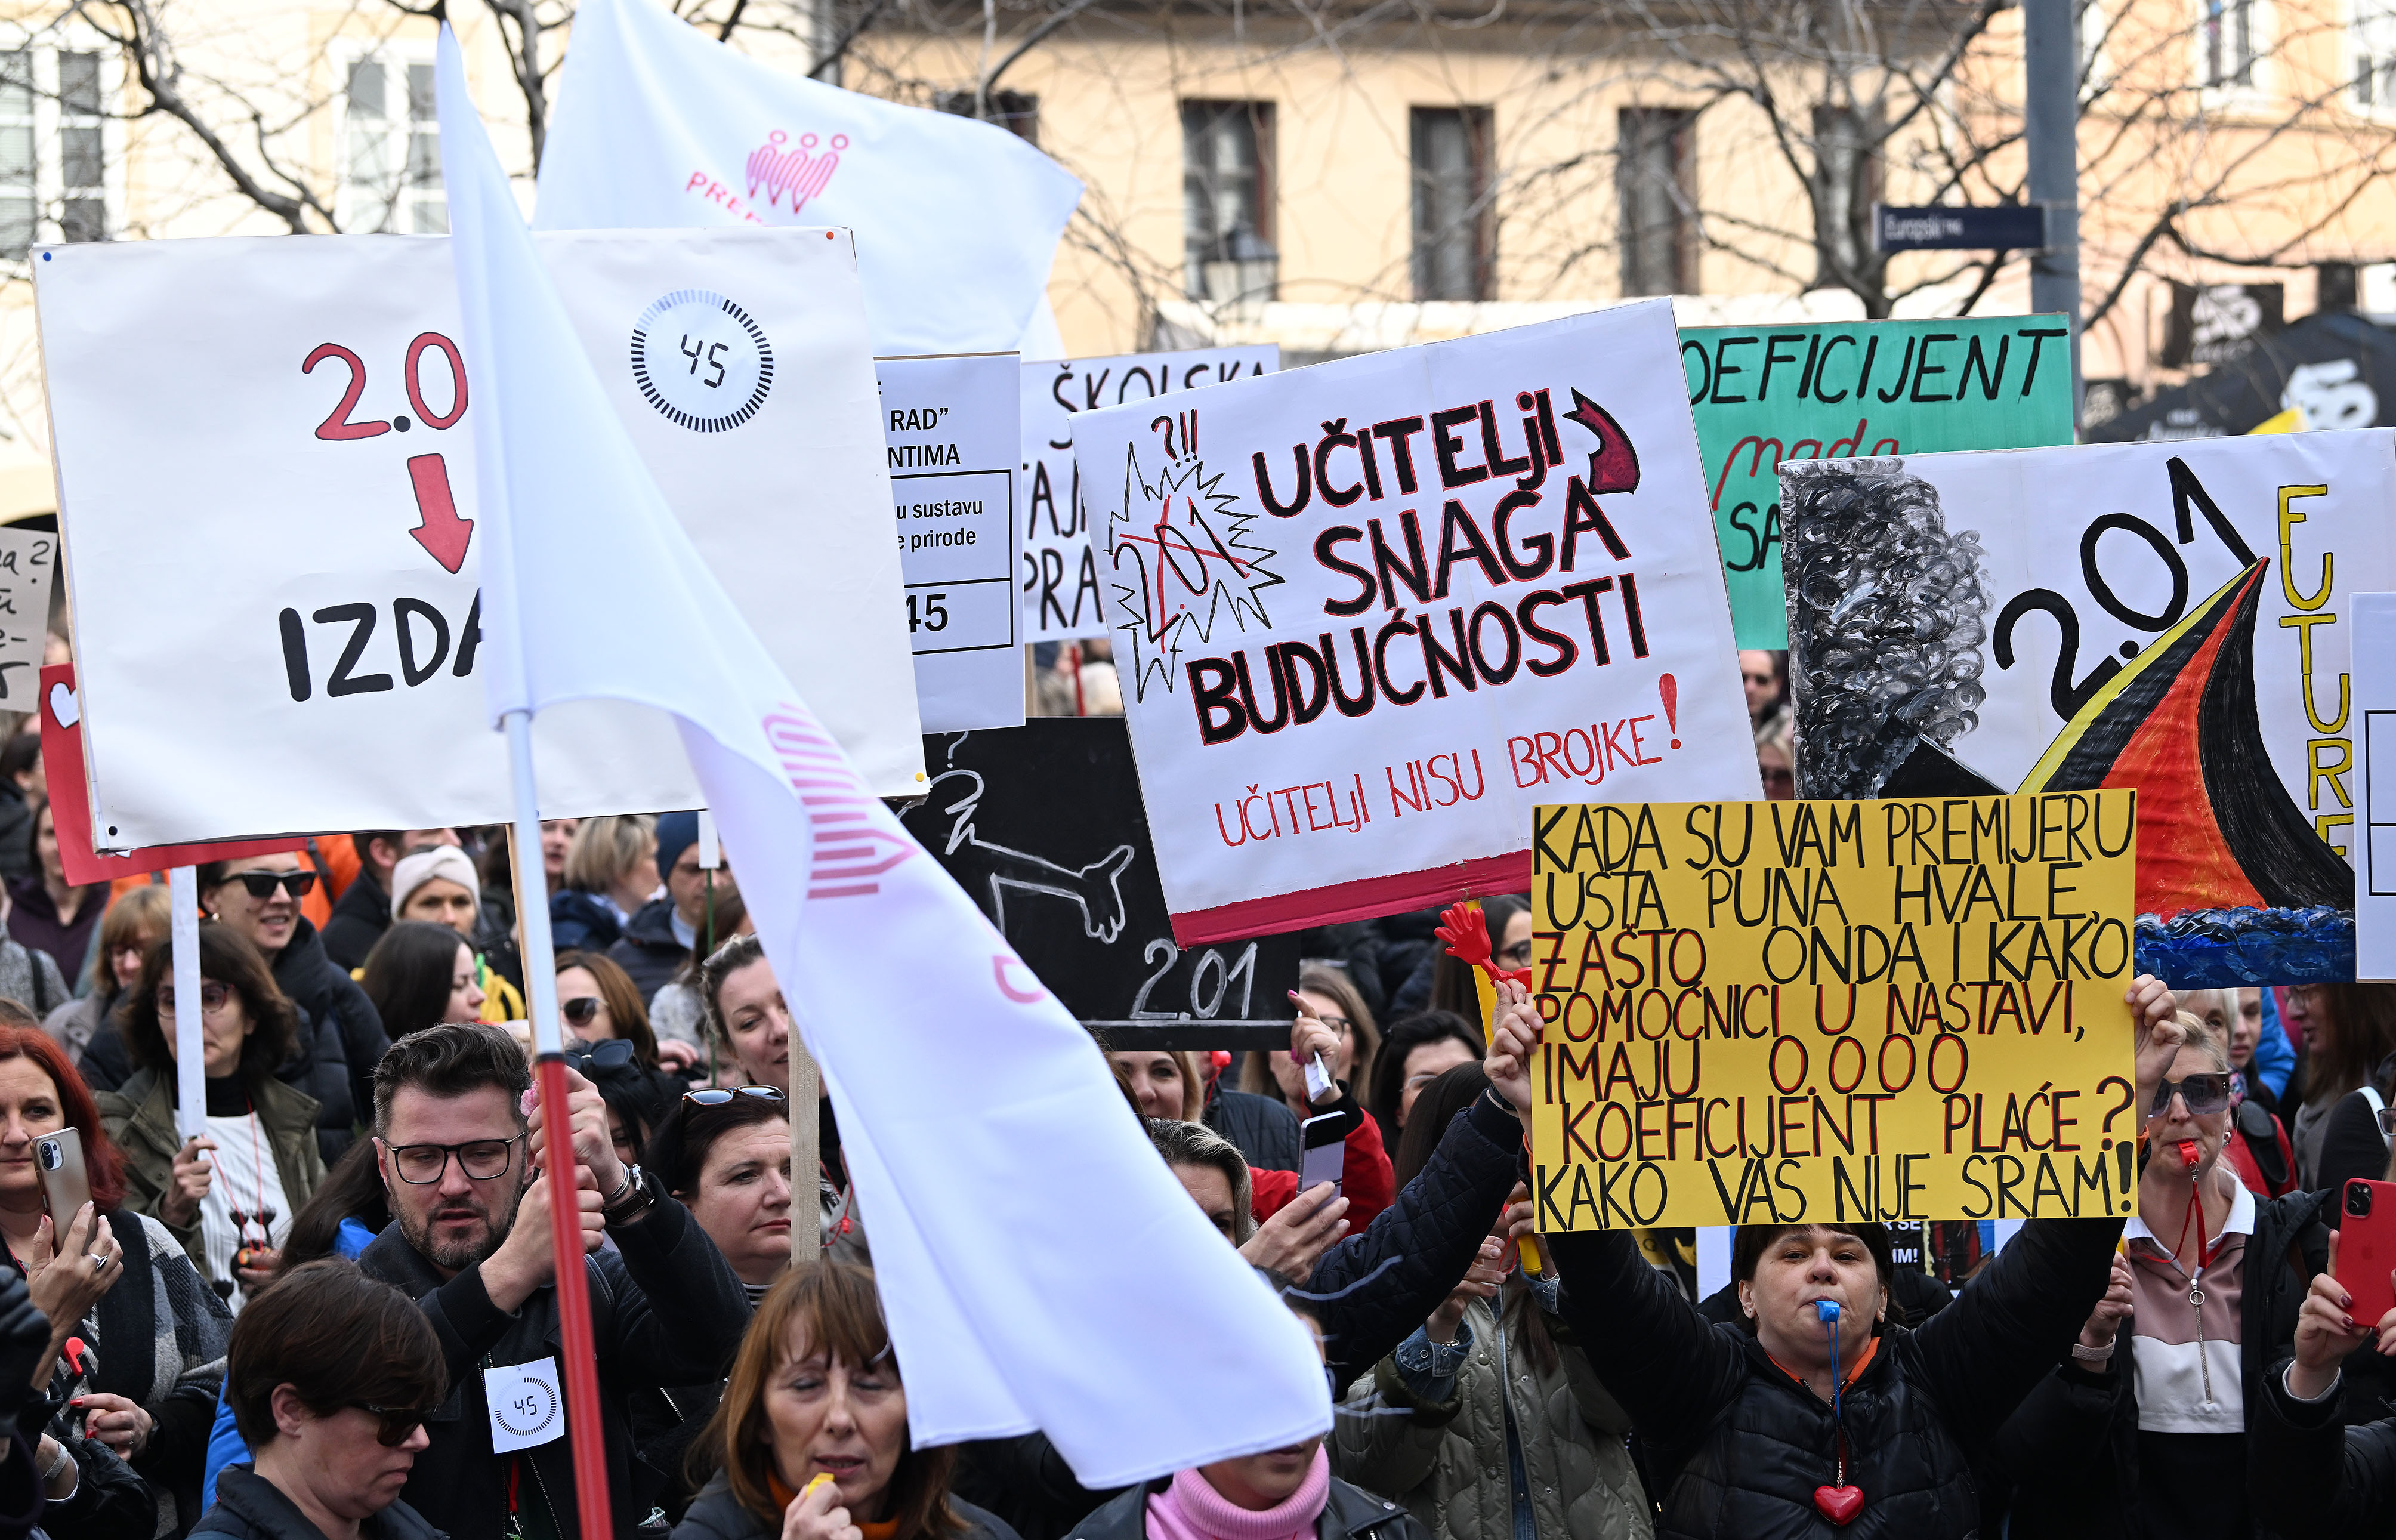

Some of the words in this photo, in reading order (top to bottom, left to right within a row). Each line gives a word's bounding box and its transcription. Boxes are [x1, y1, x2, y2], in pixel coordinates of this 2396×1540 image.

[302, 331, 468, 441] 2.0
[681, 334, 729, 388] 45
[888, 443, 961, 468] NTIMA
[1151, 408, 1198, 468] ?!!
[897, 505, 907, 520] u
[912, 499, 983, 519] sustavu
[1023, 461, 1086, 538] AJ
[910, 527, 977, 553] prirode
[1113, 496, 1251, 643] 2.01
[1313, 474, 1632, 617] SNAGA
[1993, 456, 2258, 722] 2.01
[1185, 572, 1650, 746] BUDUĆNOSTI
[1386, 749, 1485, 817] NISU
[1508, 672, 1682, 788] BROJKE!
[1533, 803, 1668, 875] KADA
[1685, 803, 1753, 871] SU
[1770, 803, 1865, 869] VAM
[1881, 790, 2136, 867] PREMIJERU
[1546, 869, 1669, 932] USTA
[1700, 866, 1848, 928] PUNA
[1894, 861, 2100, 927] HVALE,
[1129, 937, 1259, 1022] 2.01
[1762, 925, 1930, 985] ONDA
[1952, 921, 1961, 982] I
[1987, 917, 2128, 983] KAKO
[1533, 980, 1781, 1045] POMOĆNICI
[1815, 983, 1857, 1036] U
[1885, 979, 2085, 1043] NASTAVI,
[1543, 1038, 1700, 1105] IMAJU
[1561, 1093, 1897, 1165] KOEFICIJENT
[1536, 1161, 1668, 1232] KAKO
[1706, 1157, 1808, 1225] VAS
[1832, 1153, 1931, 1223] NIJE
[1960, 1140, 2135, 1219] SRAM!
[514, 1395, 538, 1415] 45
